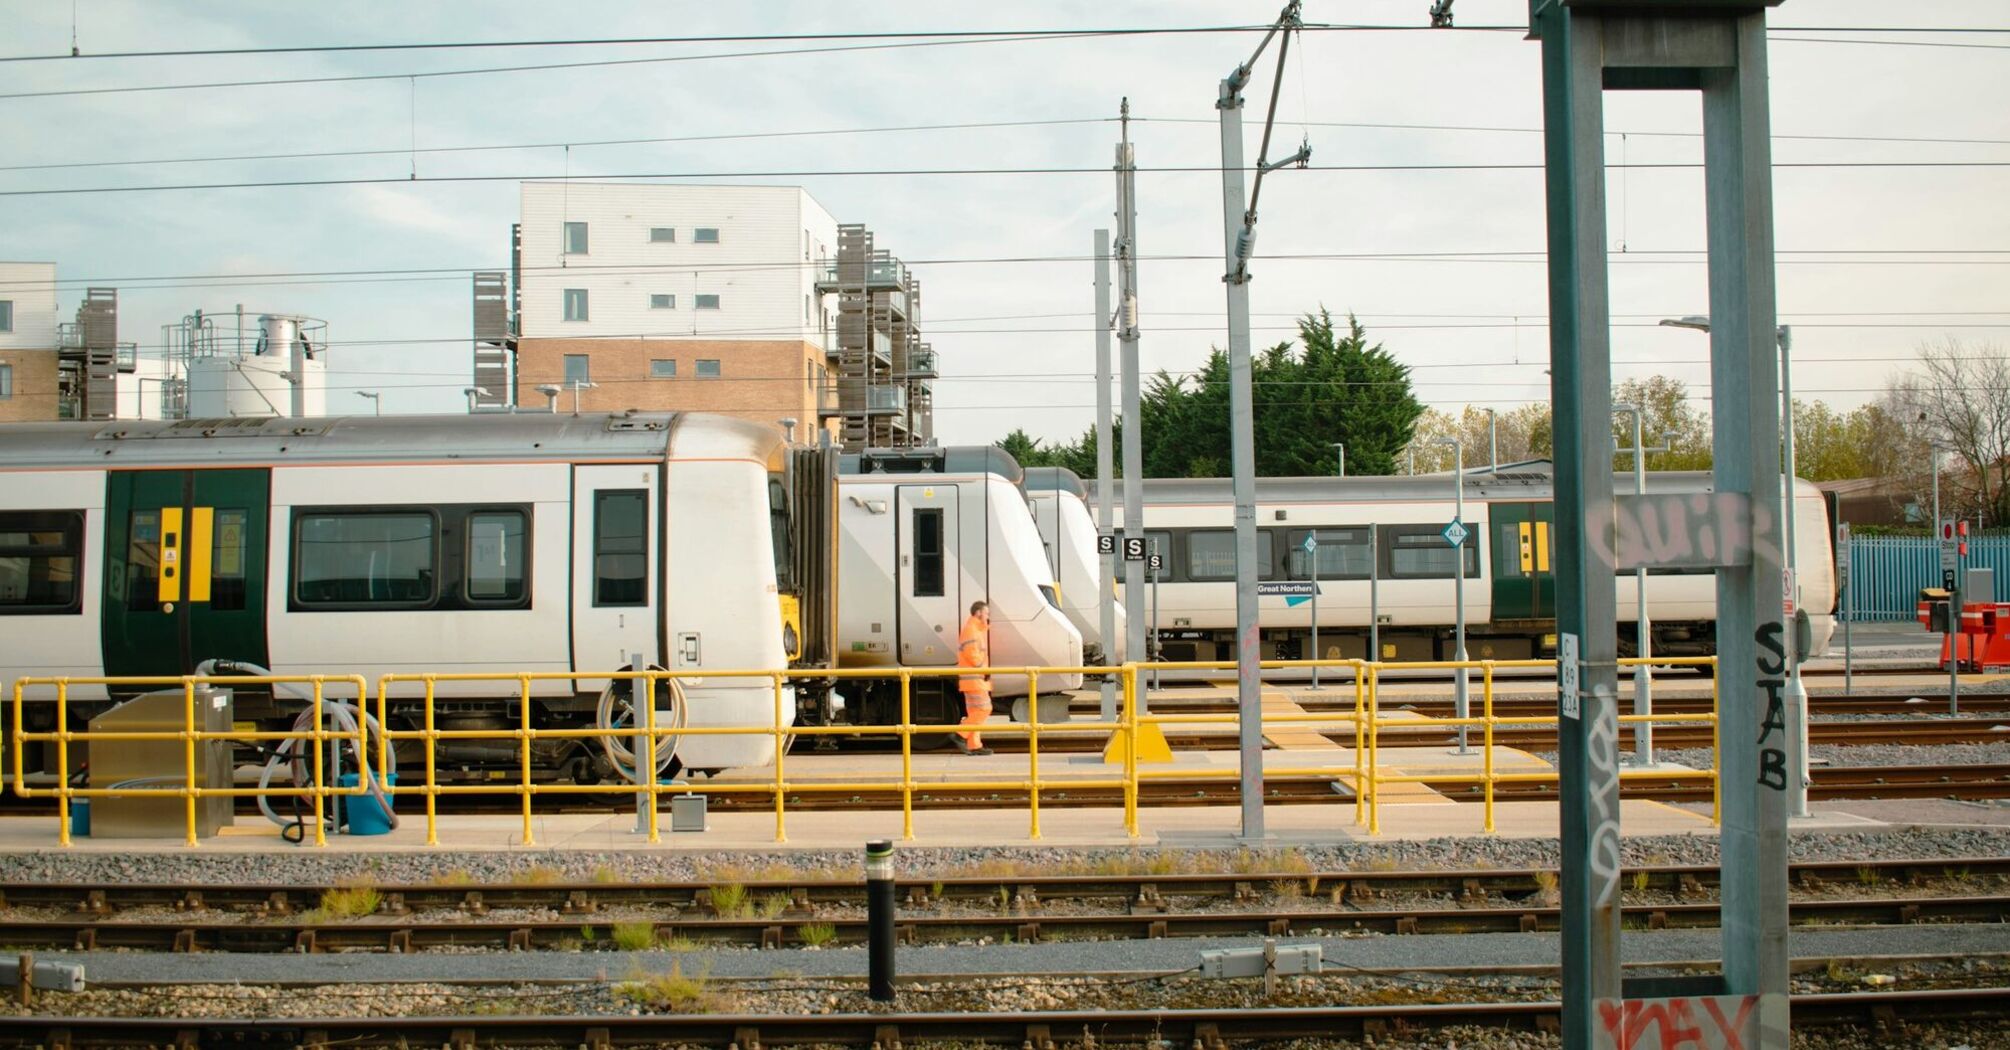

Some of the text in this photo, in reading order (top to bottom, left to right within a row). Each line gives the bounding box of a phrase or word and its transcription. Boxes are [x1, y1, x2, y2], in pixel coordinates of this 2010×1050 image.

[1448, 529, 1464, 537] ALL
[1100, 536, 1112, 550] S
[1128, 539, 1142, 555] S
[1150, 555, 1160, 567] S
[1258, 584, 1280, 593] Great
